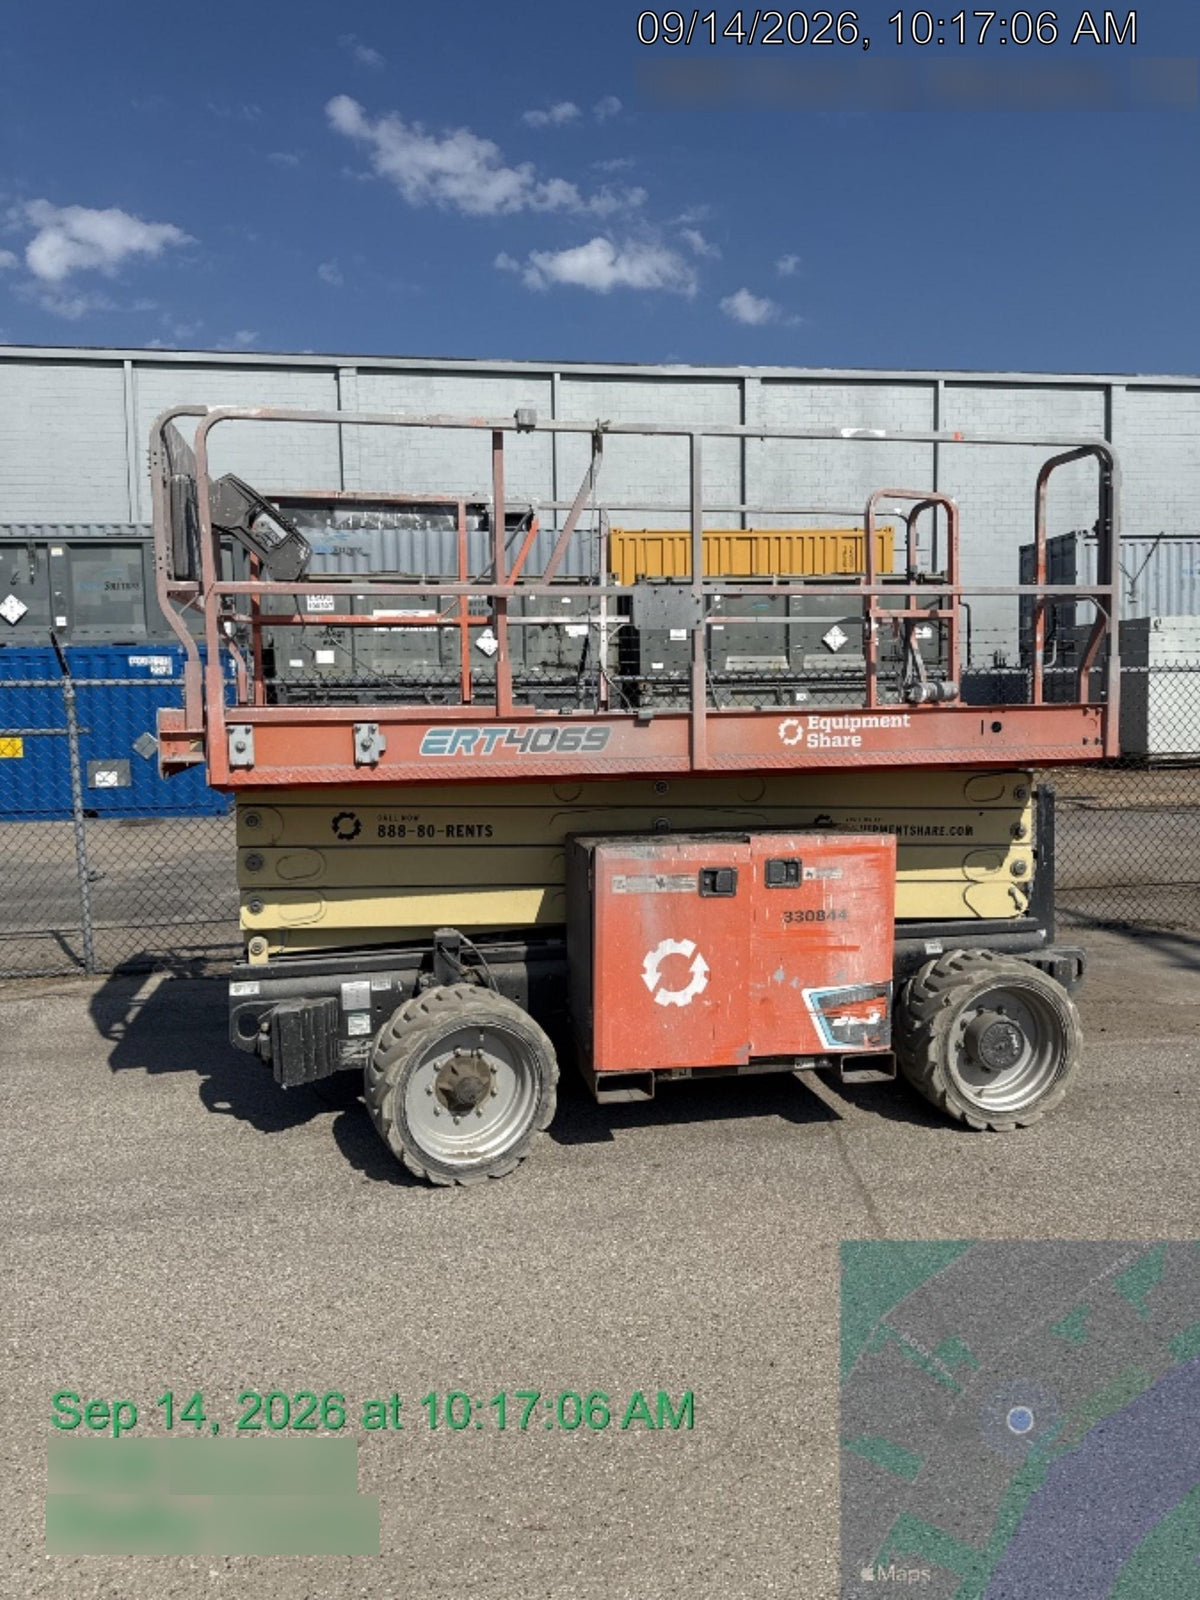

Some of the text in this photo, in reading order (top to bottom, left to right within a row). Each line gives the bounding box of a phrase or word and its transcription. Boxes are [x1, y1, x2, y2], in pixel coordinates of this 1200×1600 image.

[807, 714, 911, 732] Equipment
[419, 726, 612, 756] ERT4069
[807, 733, 862, 748] Share
[377, 824, 494, 838] 888-80-RENTS
